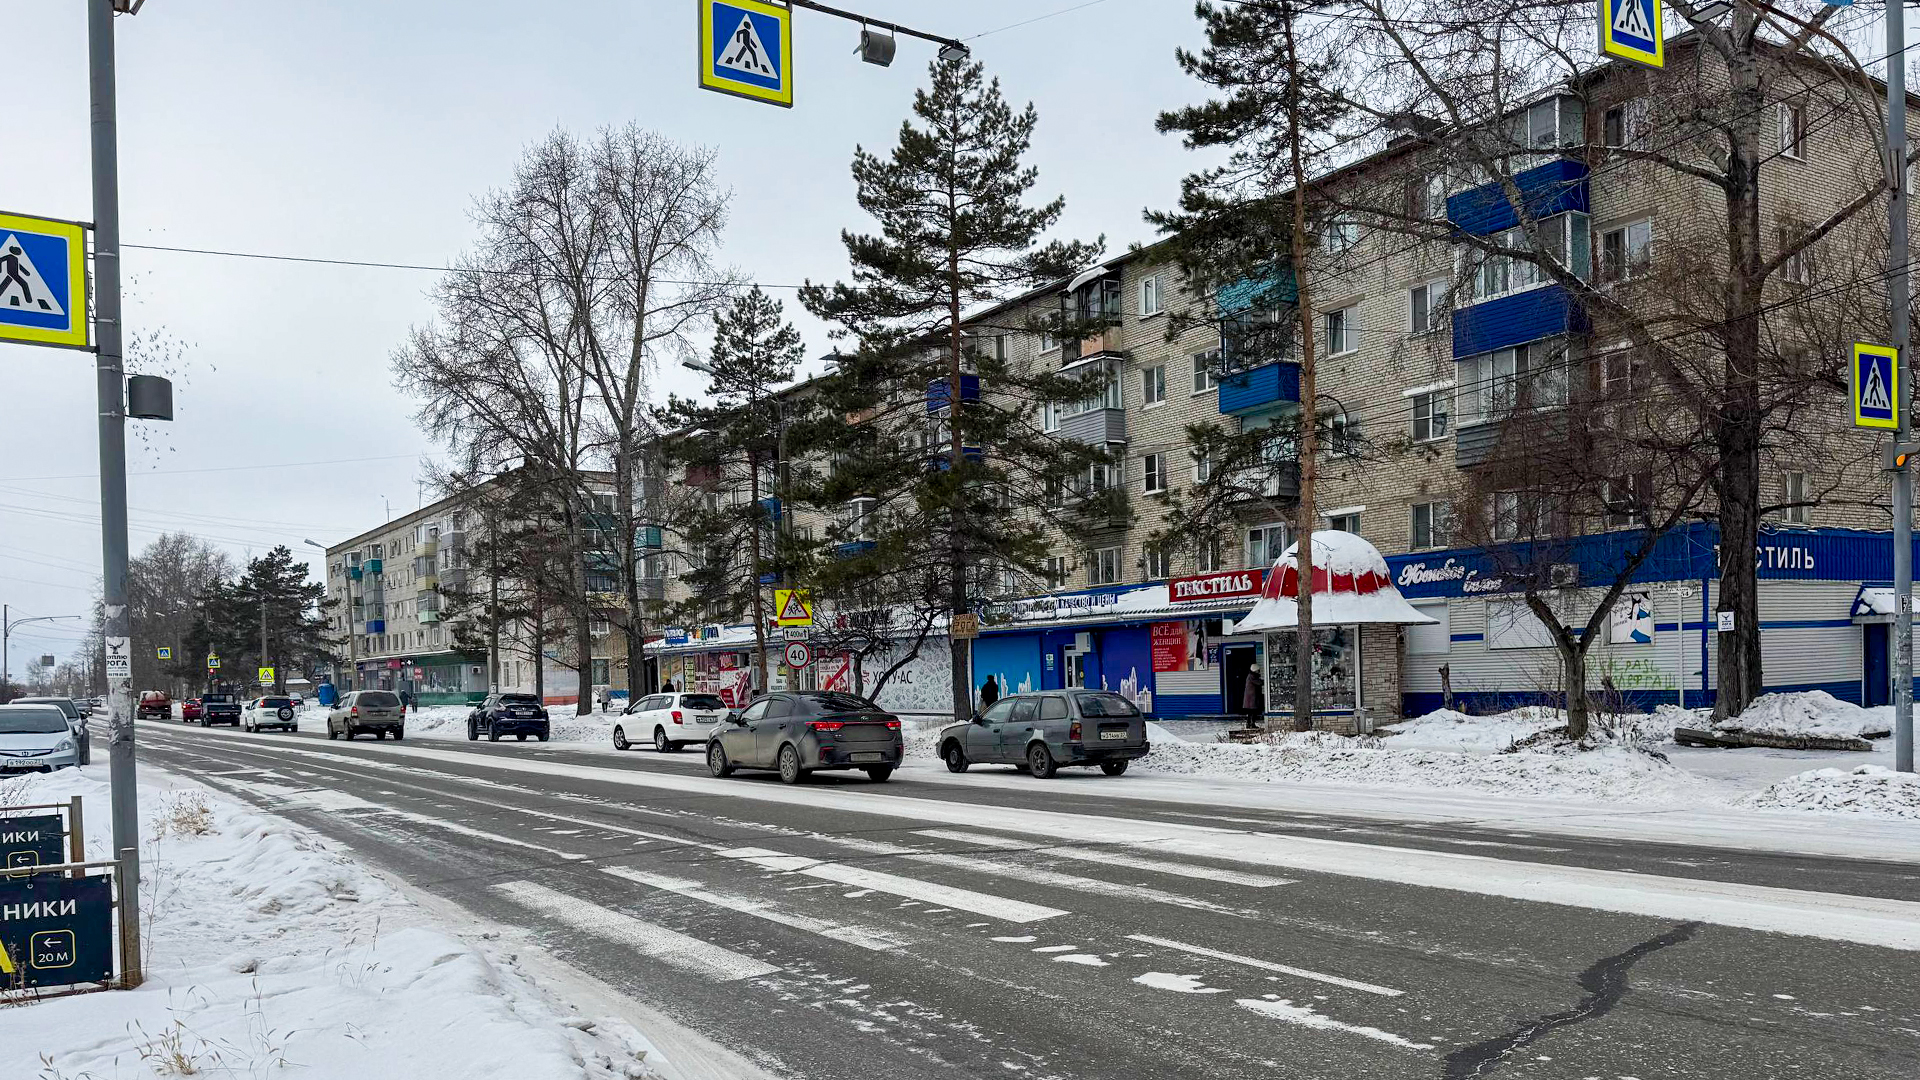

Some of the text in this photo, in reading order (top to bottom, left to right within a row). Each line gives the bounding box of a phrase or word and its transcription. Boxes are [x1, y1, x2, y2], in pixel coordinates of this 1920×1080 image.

[1174, 574, 1253, 598] ТЕКСТИЛЬ
[1152, 623, 1170, 636] ВСЁ
[790, 650, 805, 661] 40
[38, 952, 69, 963] 20 М
